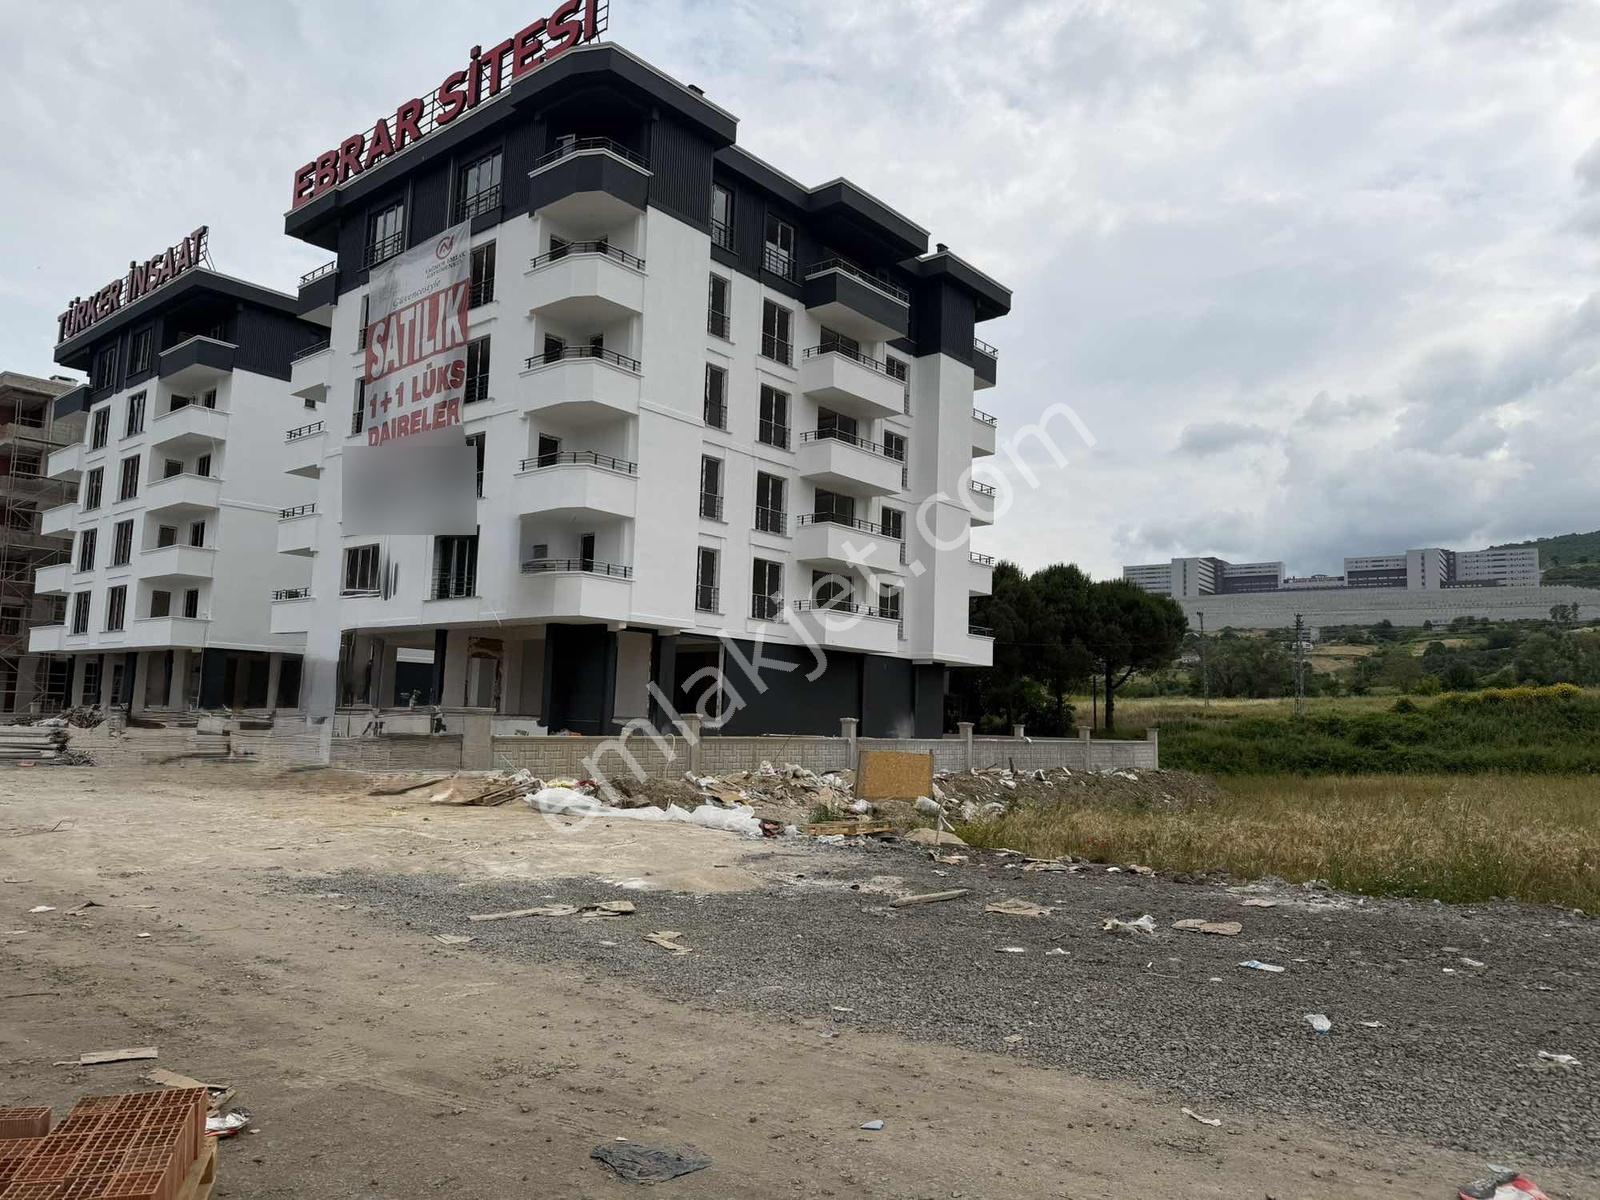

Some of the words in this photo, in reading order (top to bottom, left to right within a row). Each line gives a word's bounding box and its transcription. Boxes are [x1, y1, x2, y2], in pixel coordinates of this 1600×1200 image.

[292, 97, 426, 210] EBRAR
[57, 278, 123, 343] TÜRKER
[370, 283, 466, 379] SATILIK
[411, 359, 466, 402] LÜKS
